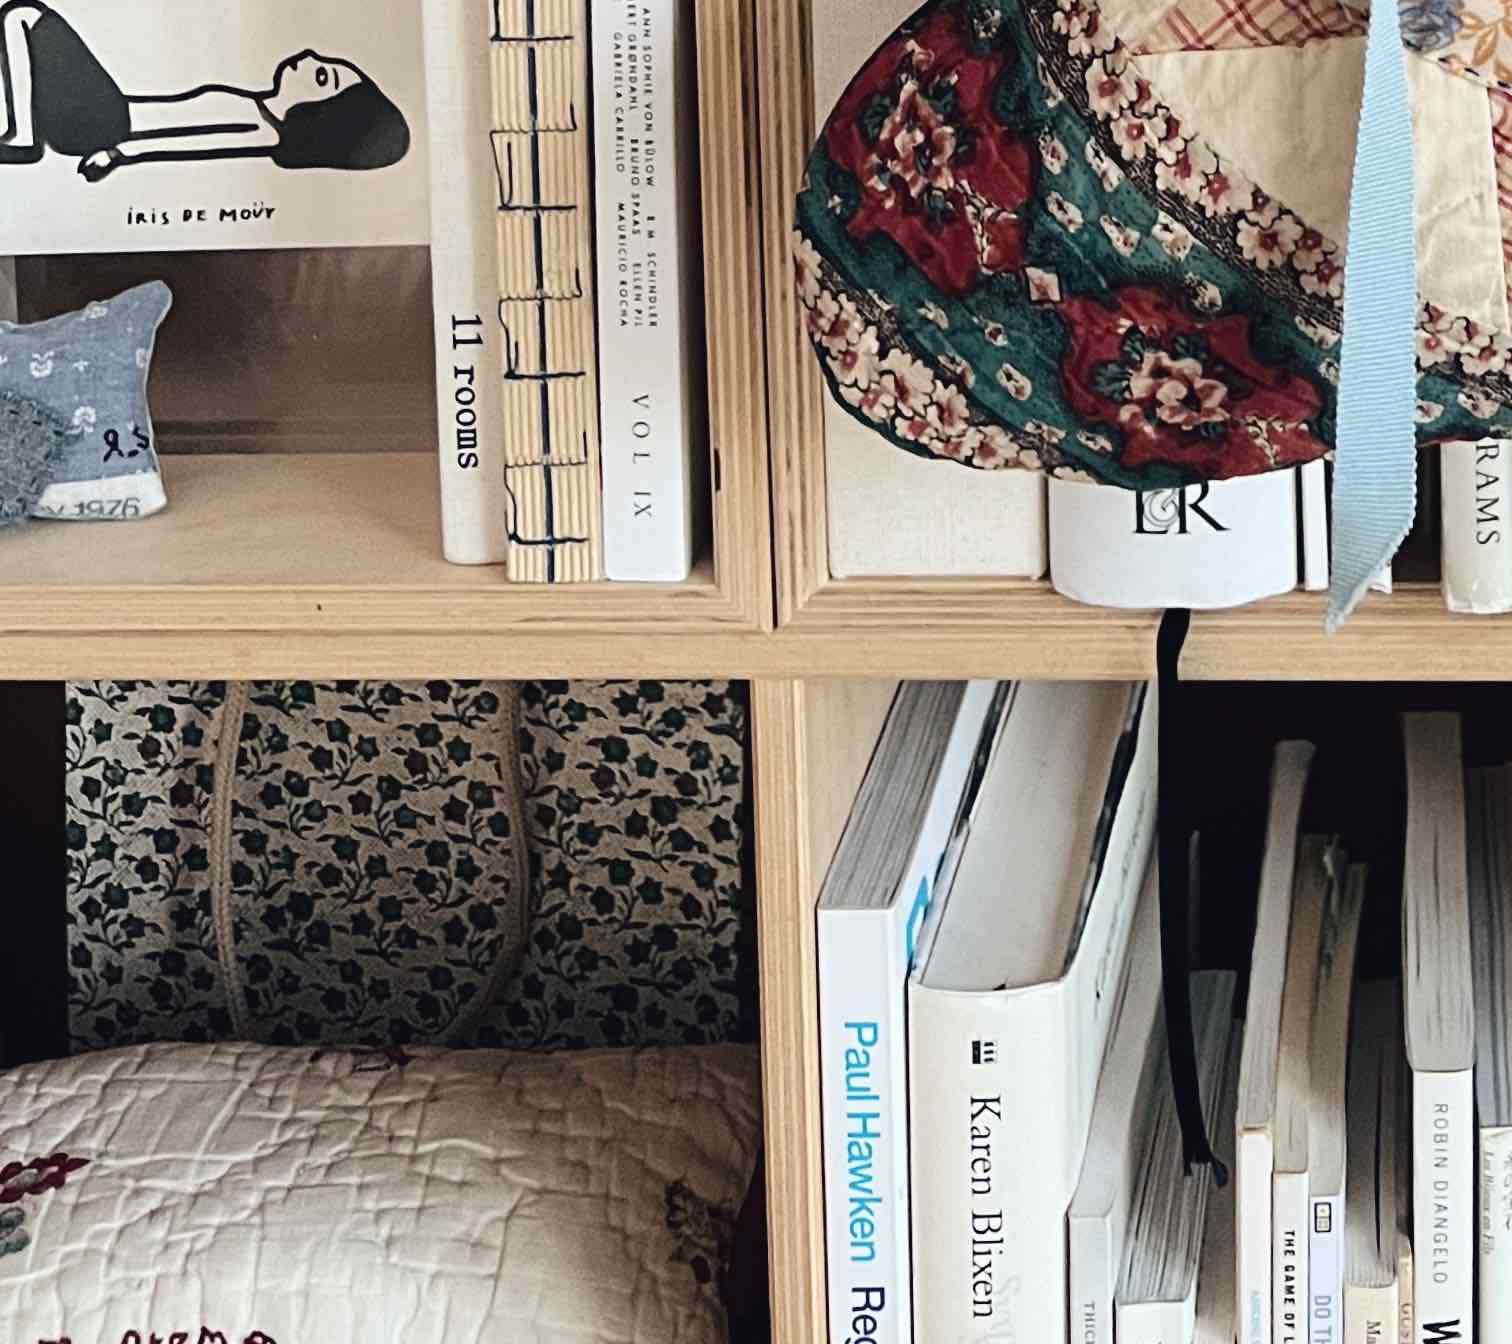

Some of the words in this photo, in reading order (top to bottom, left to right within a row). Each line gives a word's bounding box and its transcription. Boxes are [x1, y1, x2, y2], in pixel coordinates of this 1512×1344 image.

[642, 8, 652, 38] ANN
[648, 252, 658, 327] SCHINDLER
[182, 208, 207, 223] DE
[454, 365, 480, 470] rooms
[631, 394, 652, 465] VOL
[633, 490, 652, 517] IX
[844, 1021, 880, 1101] Paul
[969, 1095, 1002, 1196] Karen
[1432, 1103, 1449, 1169] ROBIN
[845, 1111, 883, 1262] Hawken
[971, 1209, 1005, 1320] Blixen
[1283, 1230, 1296, 1257] THE
[1432, 1180, 1449, 1285] DIANGELO
[844, 1286, 886, 1344] Re
[1283, 1265, 1296, 1305] GAME
[1314, 1295, 1332, 1320] DO
[1283, 1313, 1296, 1329] OF
